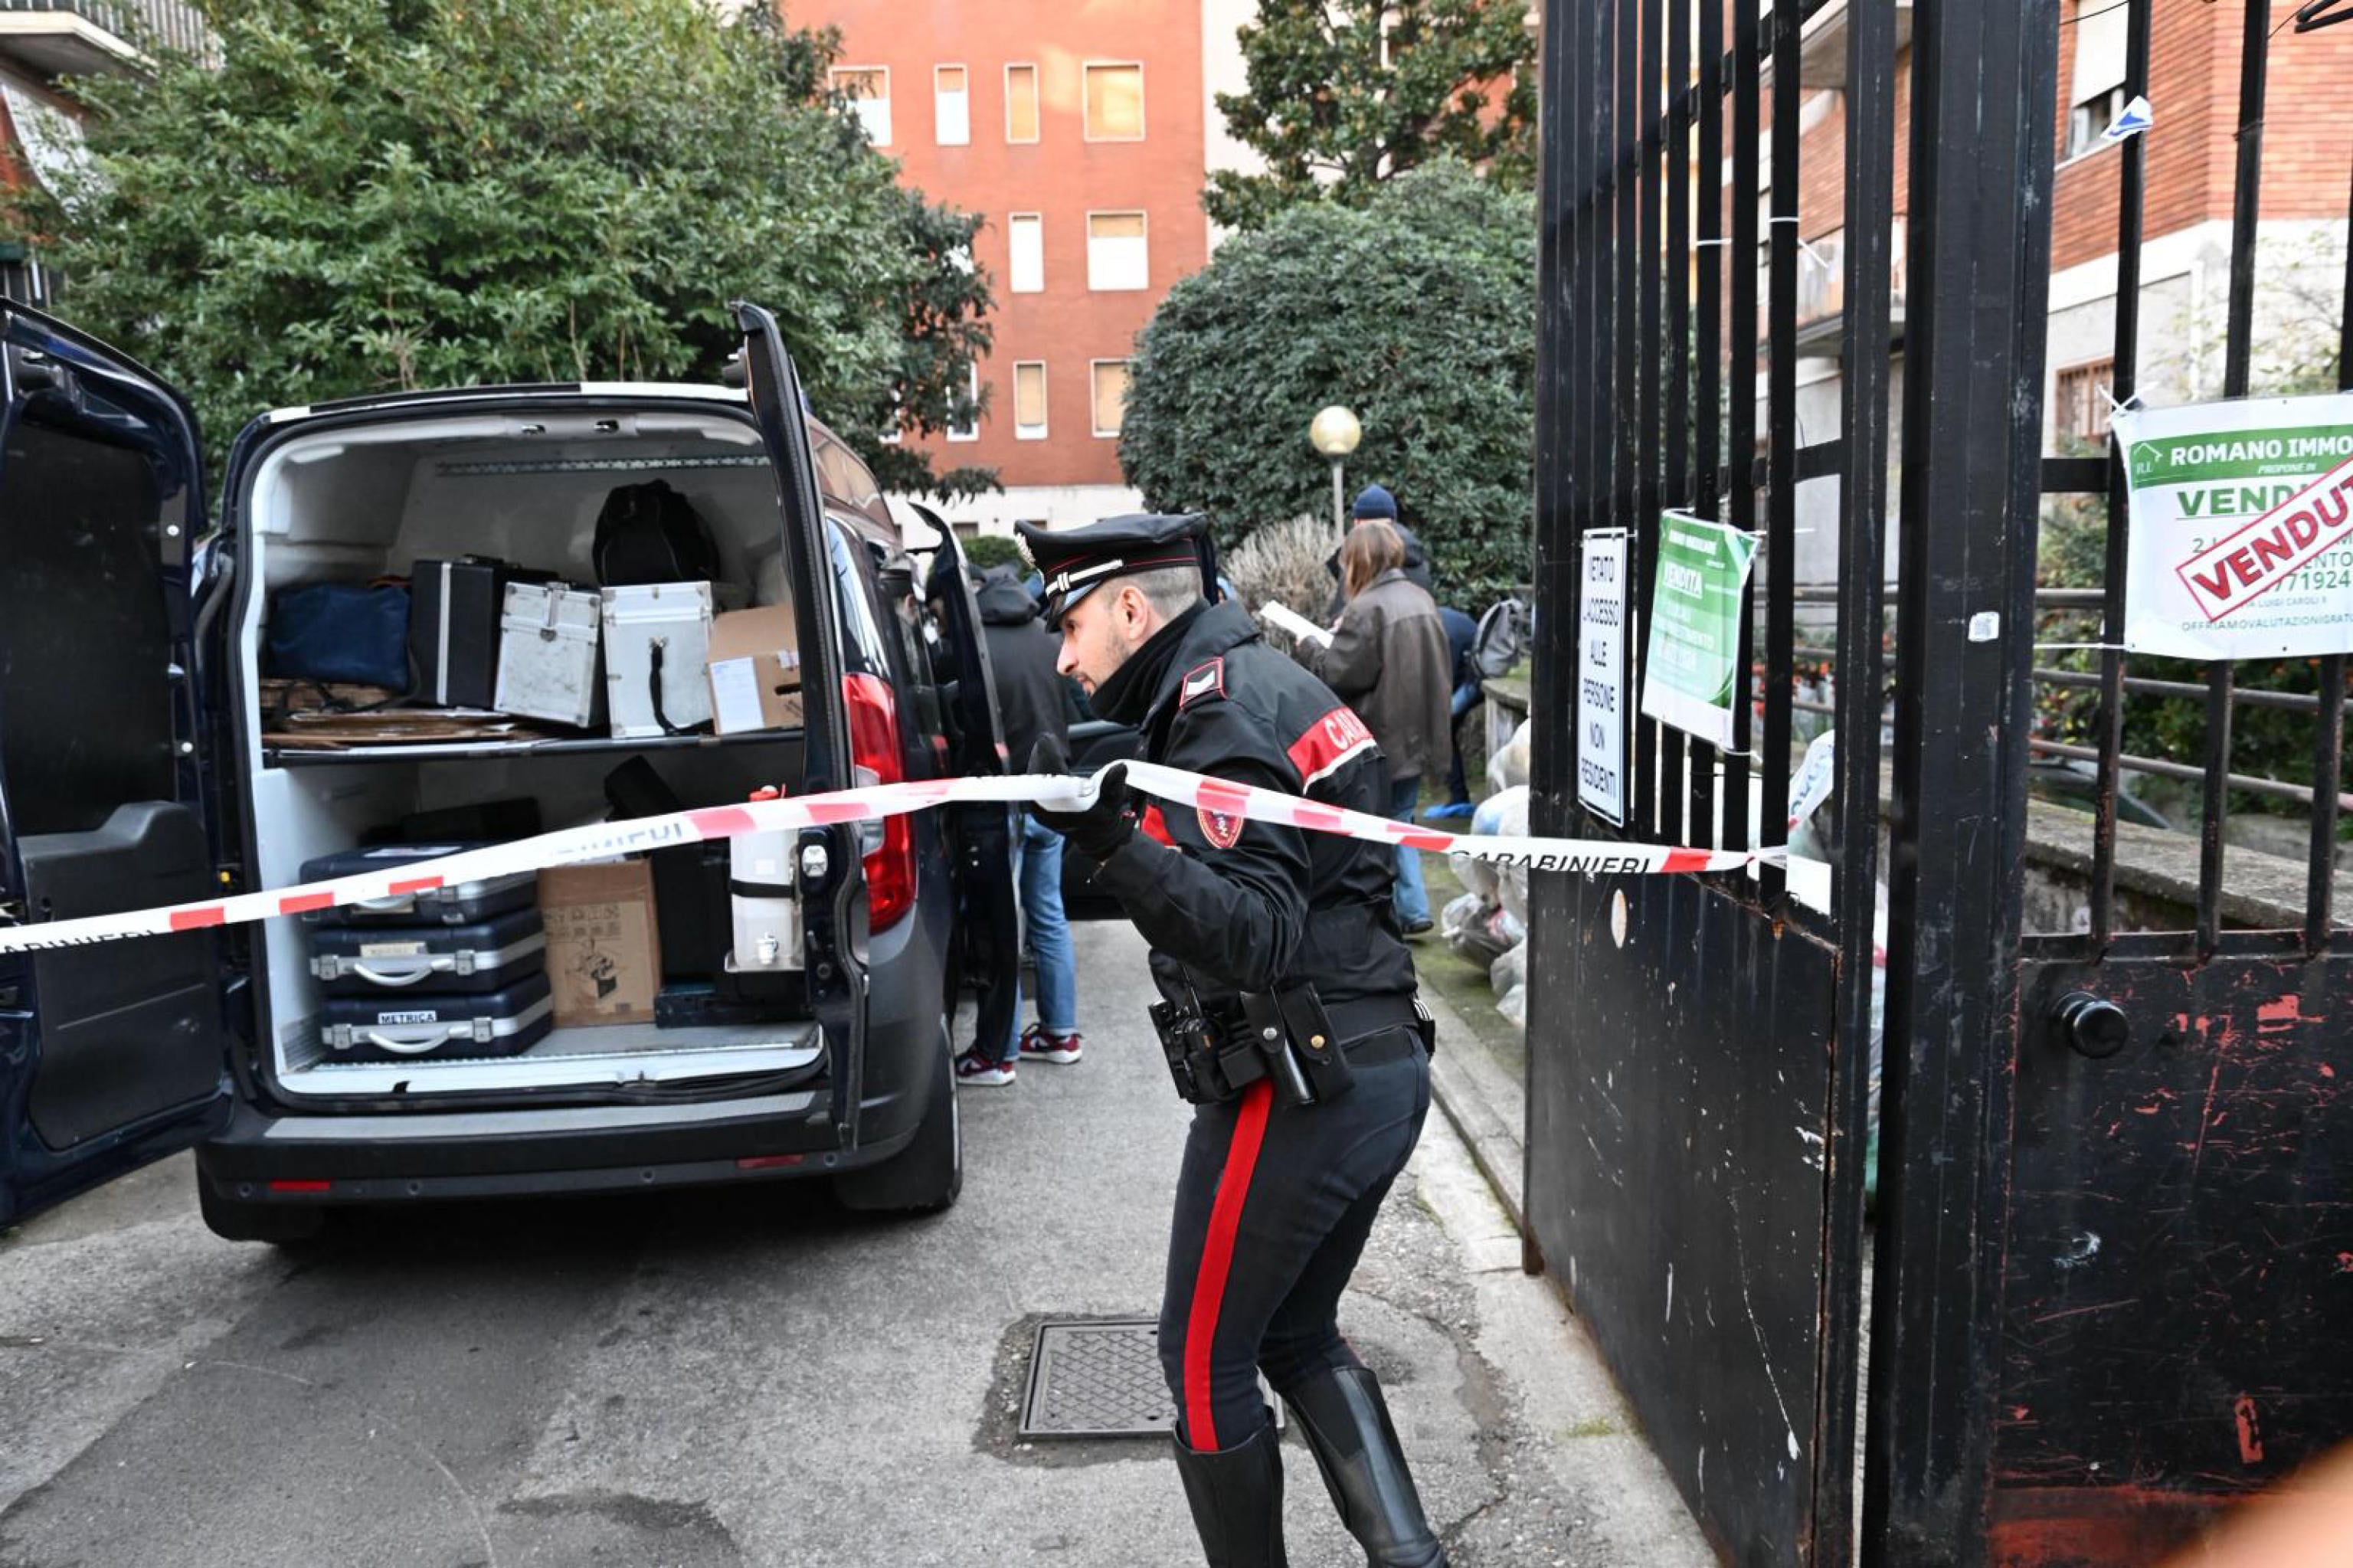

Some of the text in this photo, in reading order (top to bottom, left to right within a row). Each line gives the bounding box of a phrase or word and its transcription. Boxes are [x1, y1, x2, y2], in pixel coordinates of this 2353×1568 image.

[2170, 435, 2353, 466] ROMANO IMMO
[2177, 483, 2308, 516] VEND
[1589, 721, 1605, 751] NON
[1451, 849, 1651, 873] ARABINIERI
[381, 1013, 434, 1024] METRICA
